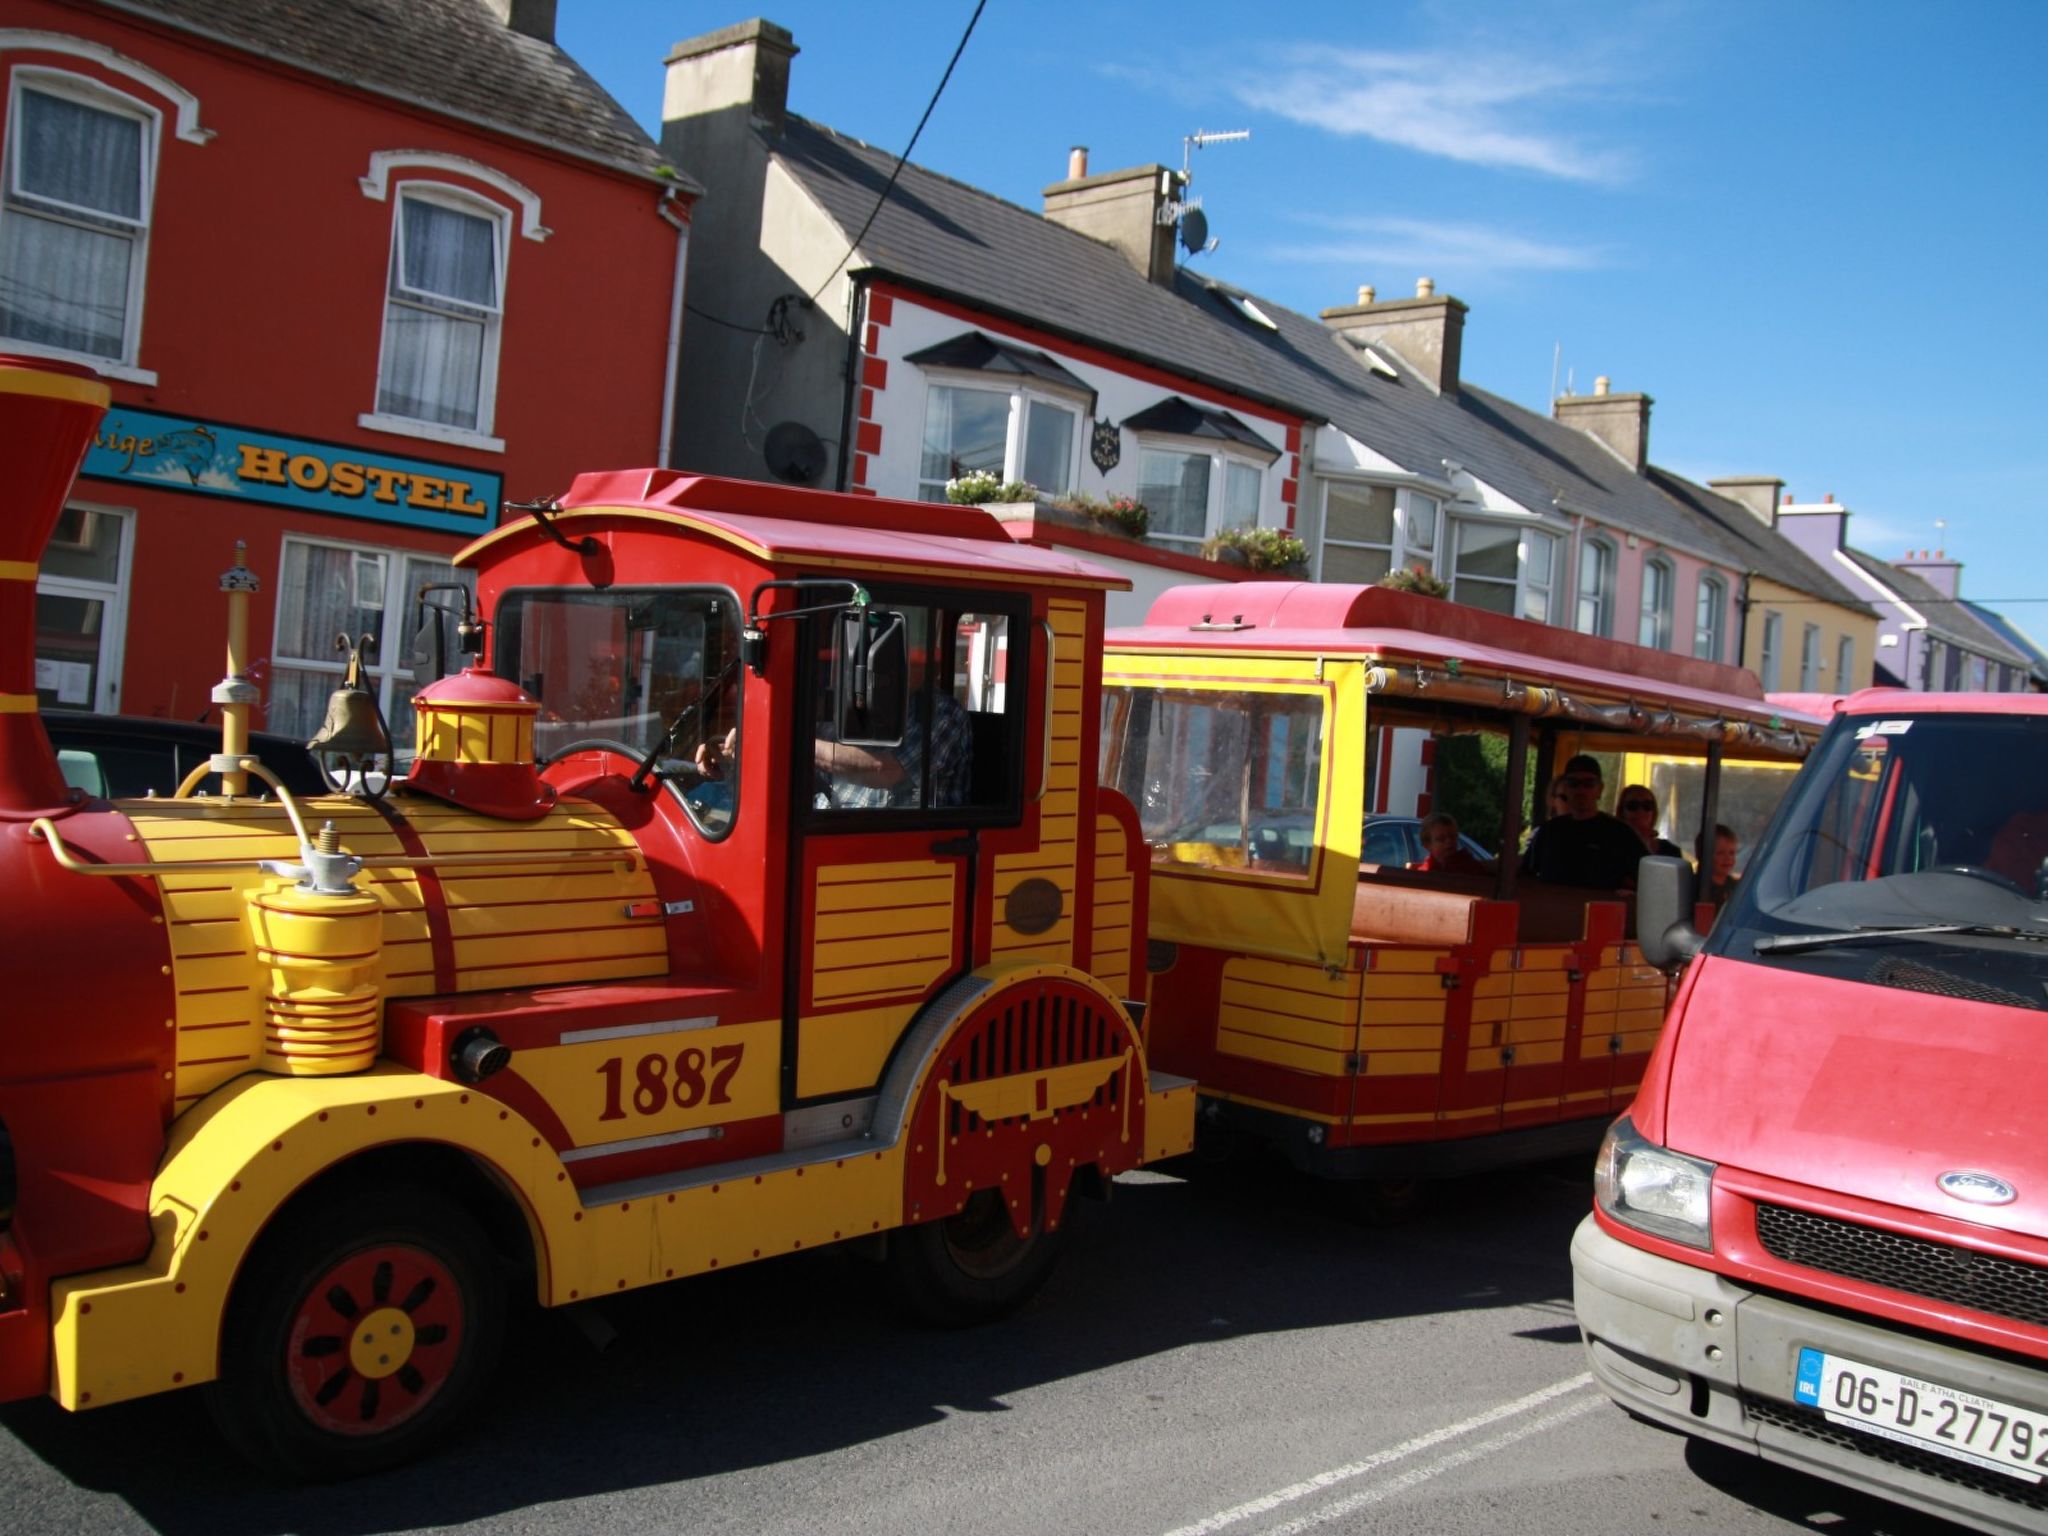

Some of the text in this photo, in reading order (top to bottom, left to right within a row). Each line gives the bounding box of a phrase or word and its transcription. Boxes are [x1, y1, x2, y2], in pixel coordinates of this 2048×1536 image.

[237, 444, 488, 517] HOSTEL
[596, 1041, 744, 1122] 1887
[1946, 1174, 2009, 1202] Ford
[1799, 1380, 1817, 1397] IRL
[1900, 1376, 1928, 1392] BAILE
[1958, 1394, 1994, 1410] CLIATH
